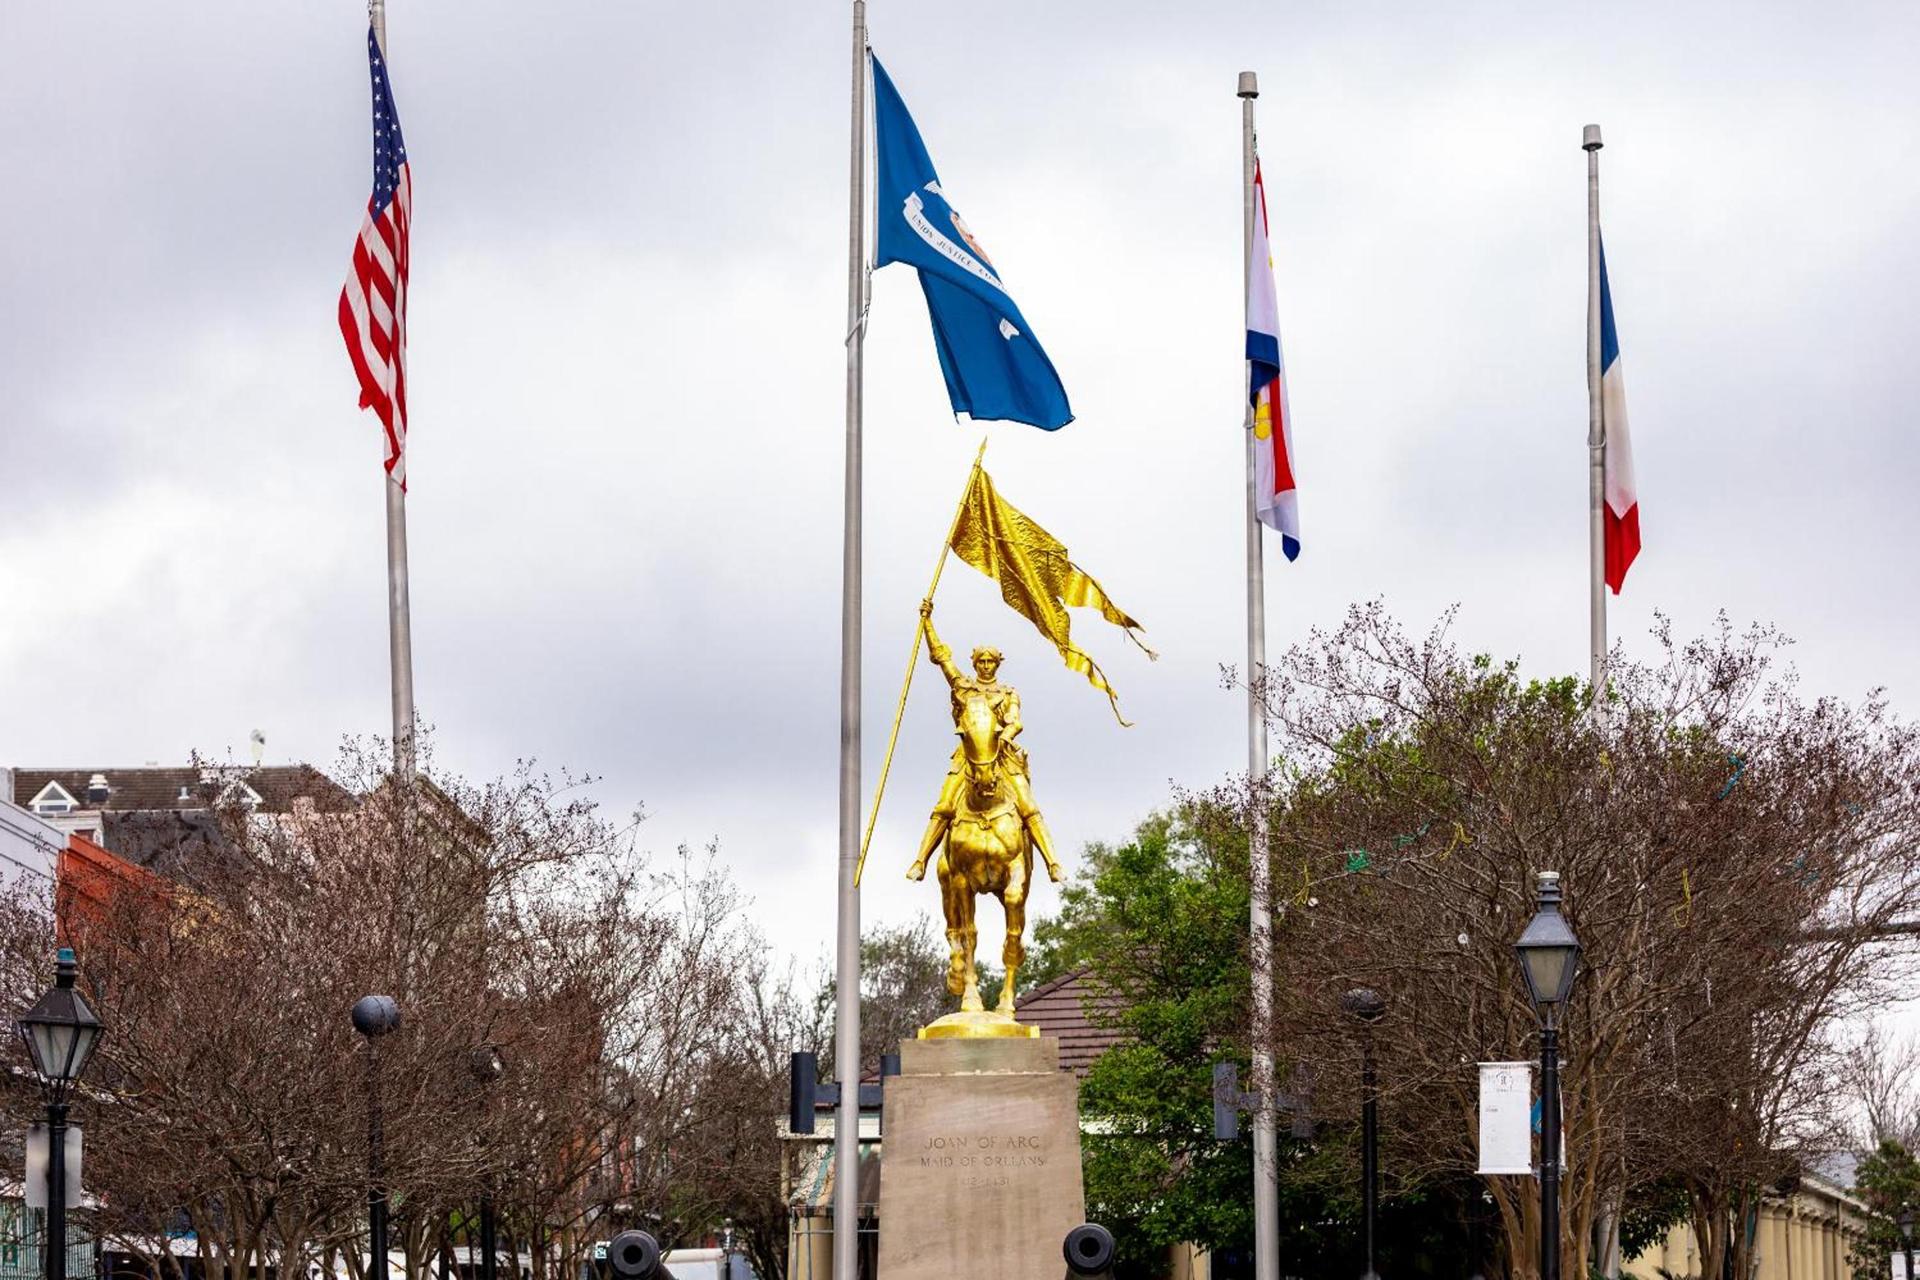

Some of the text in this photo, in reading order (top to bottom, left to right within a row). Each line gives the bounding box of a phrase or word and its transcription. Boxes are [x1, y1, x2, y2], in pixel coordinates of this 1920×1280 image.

[911, 214, 972, 266] UNION JUSTICE
[924, 1136, 1040, 1150] JOAN OF ARC
[920, 1156, 953, 1167] MAID
[960, 1156, 977, 1167] OF
